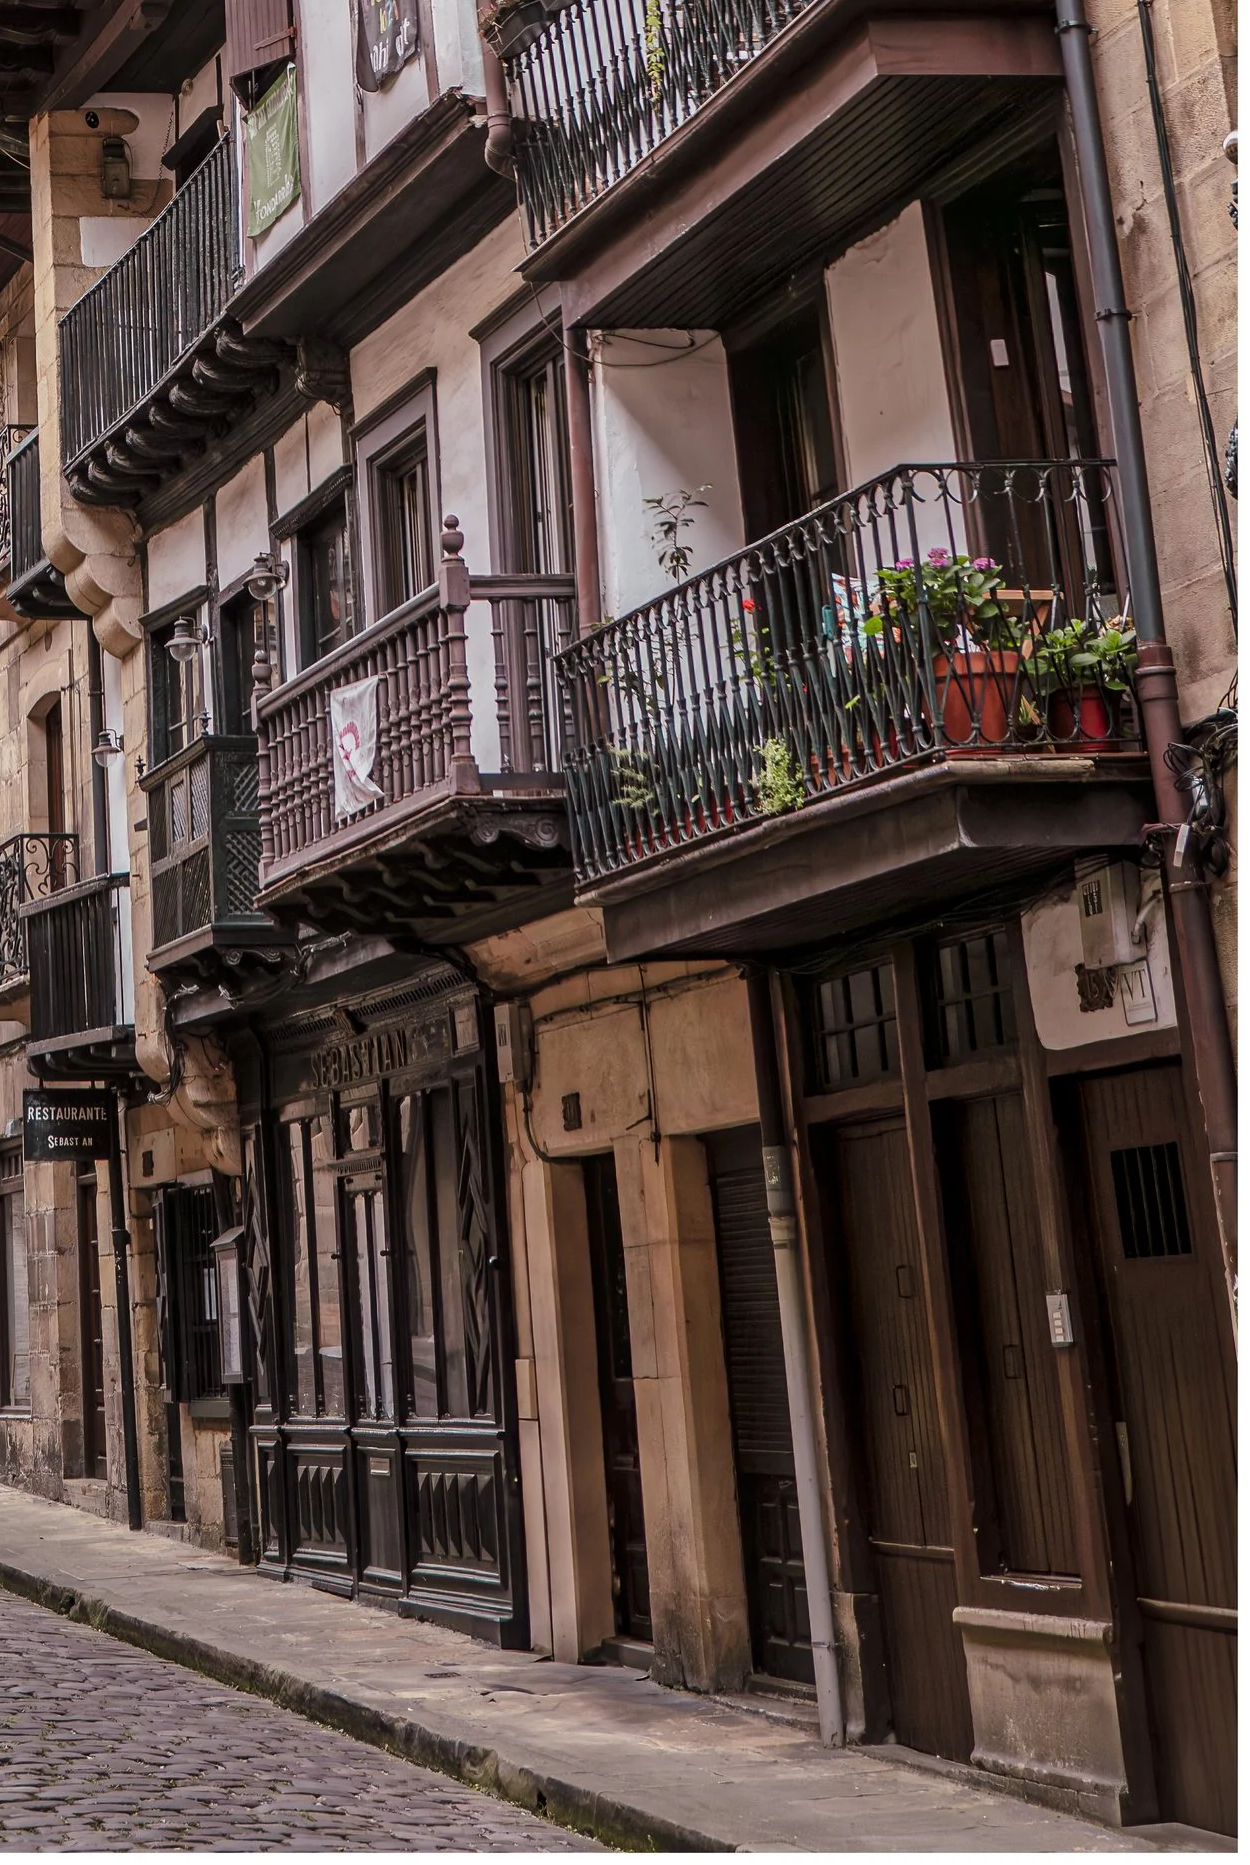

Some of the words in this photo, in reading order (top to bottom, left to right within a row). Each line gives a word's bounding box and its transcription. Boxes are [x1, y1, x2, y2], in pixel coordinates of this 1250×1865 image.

[310, 1028, 408, 1088] SEBASTIAN
[27, 1106, 108, 1121] RESTAURANTE
[47, 1134, 93, 1149] SEBASTAN
